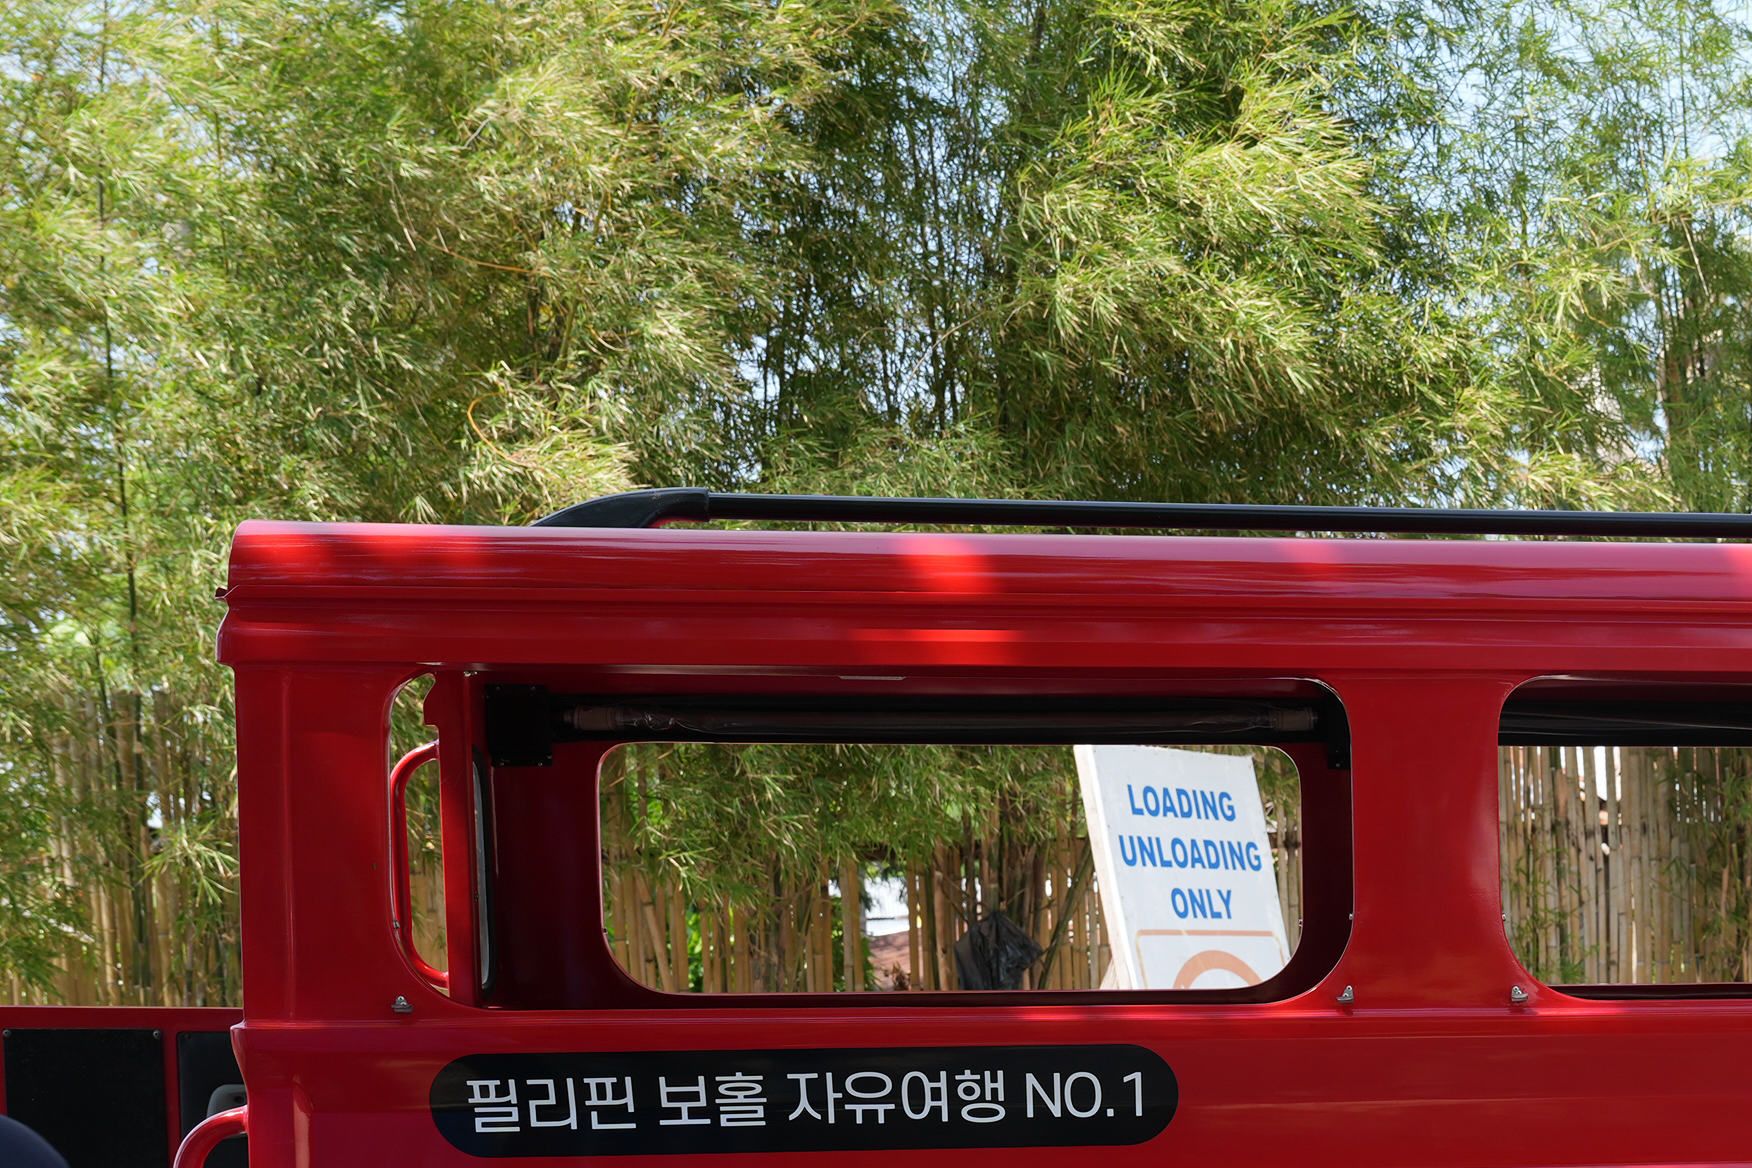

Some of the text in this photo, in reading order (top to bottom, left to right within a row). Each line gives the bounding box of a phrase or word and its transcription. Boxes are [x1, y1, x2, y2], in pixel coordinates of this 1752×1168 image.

[1126, 784, 1236, 822] LOADING
[1118, 835, 1262, 871] UNLOADING
[1170, 887, 1232, 919] ONLY
[467, 1067, 1146, 1133] 필리핀 보홀 자유여행 NO.1
